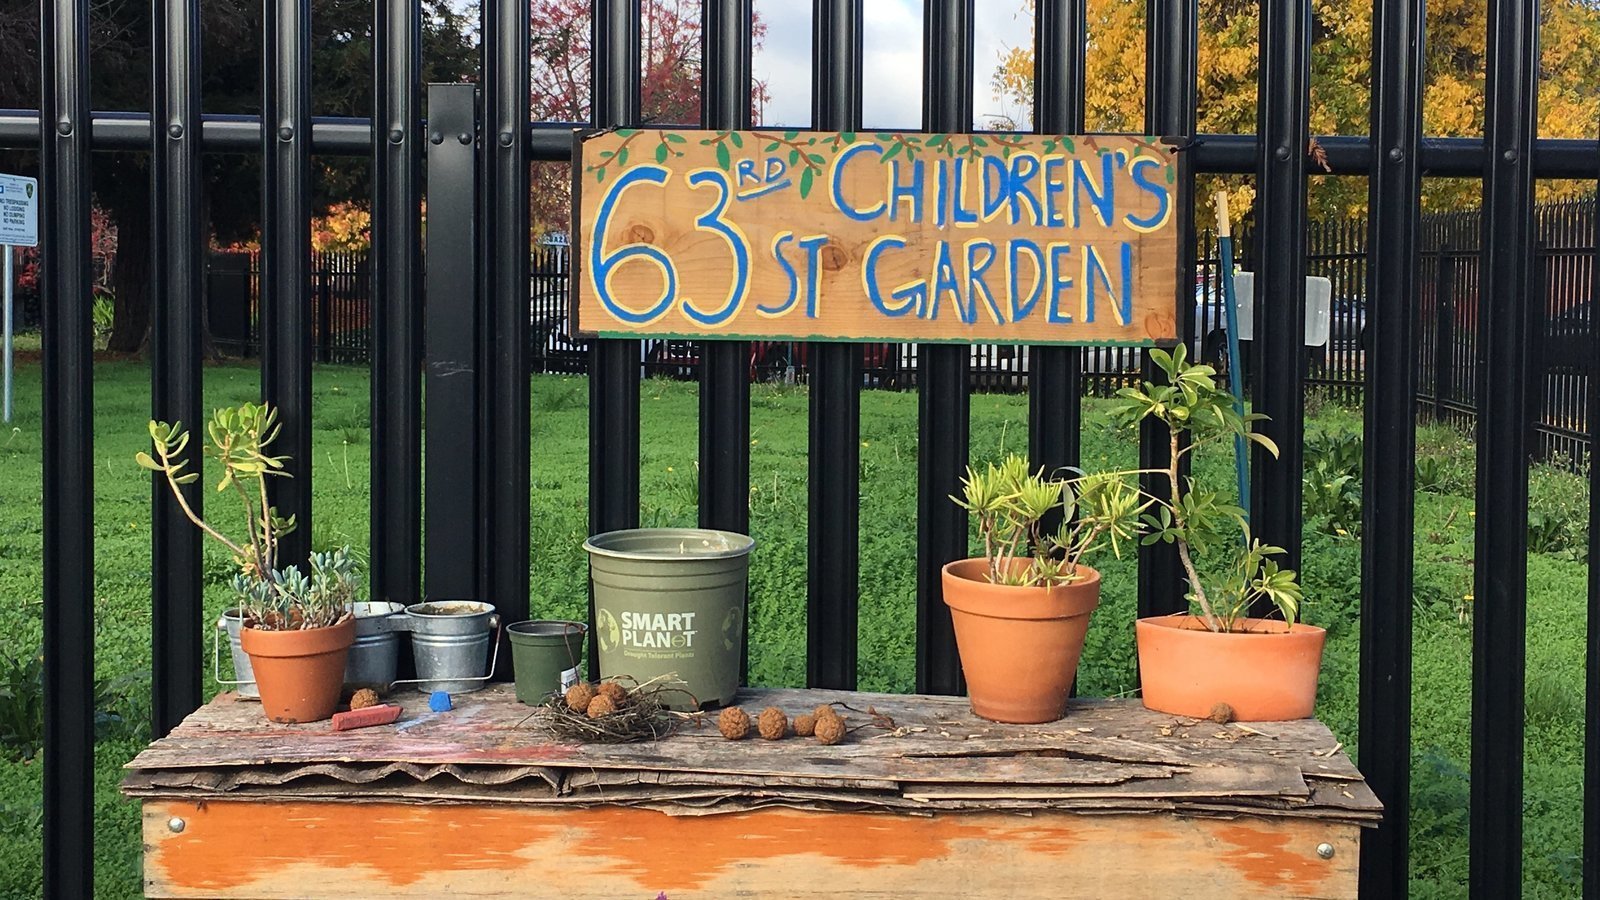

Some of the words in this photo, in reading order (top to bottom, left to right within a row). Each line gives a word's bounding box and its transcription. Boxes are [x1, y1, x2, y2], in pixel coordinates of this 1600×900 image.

[829, 141, 1172, 233] CHILDREN'S
[6, 198, 29, 206] TRESPASSING
[755, 230, 828, 319] ST
[861, 234, 1132, 326] GARDEN
[621, 611, 695, 631] SMART
[623, 650, 647, 659] Drought
[648, 651, 674, 659] Tolerant
[674, 651, 695, 659] Plants
